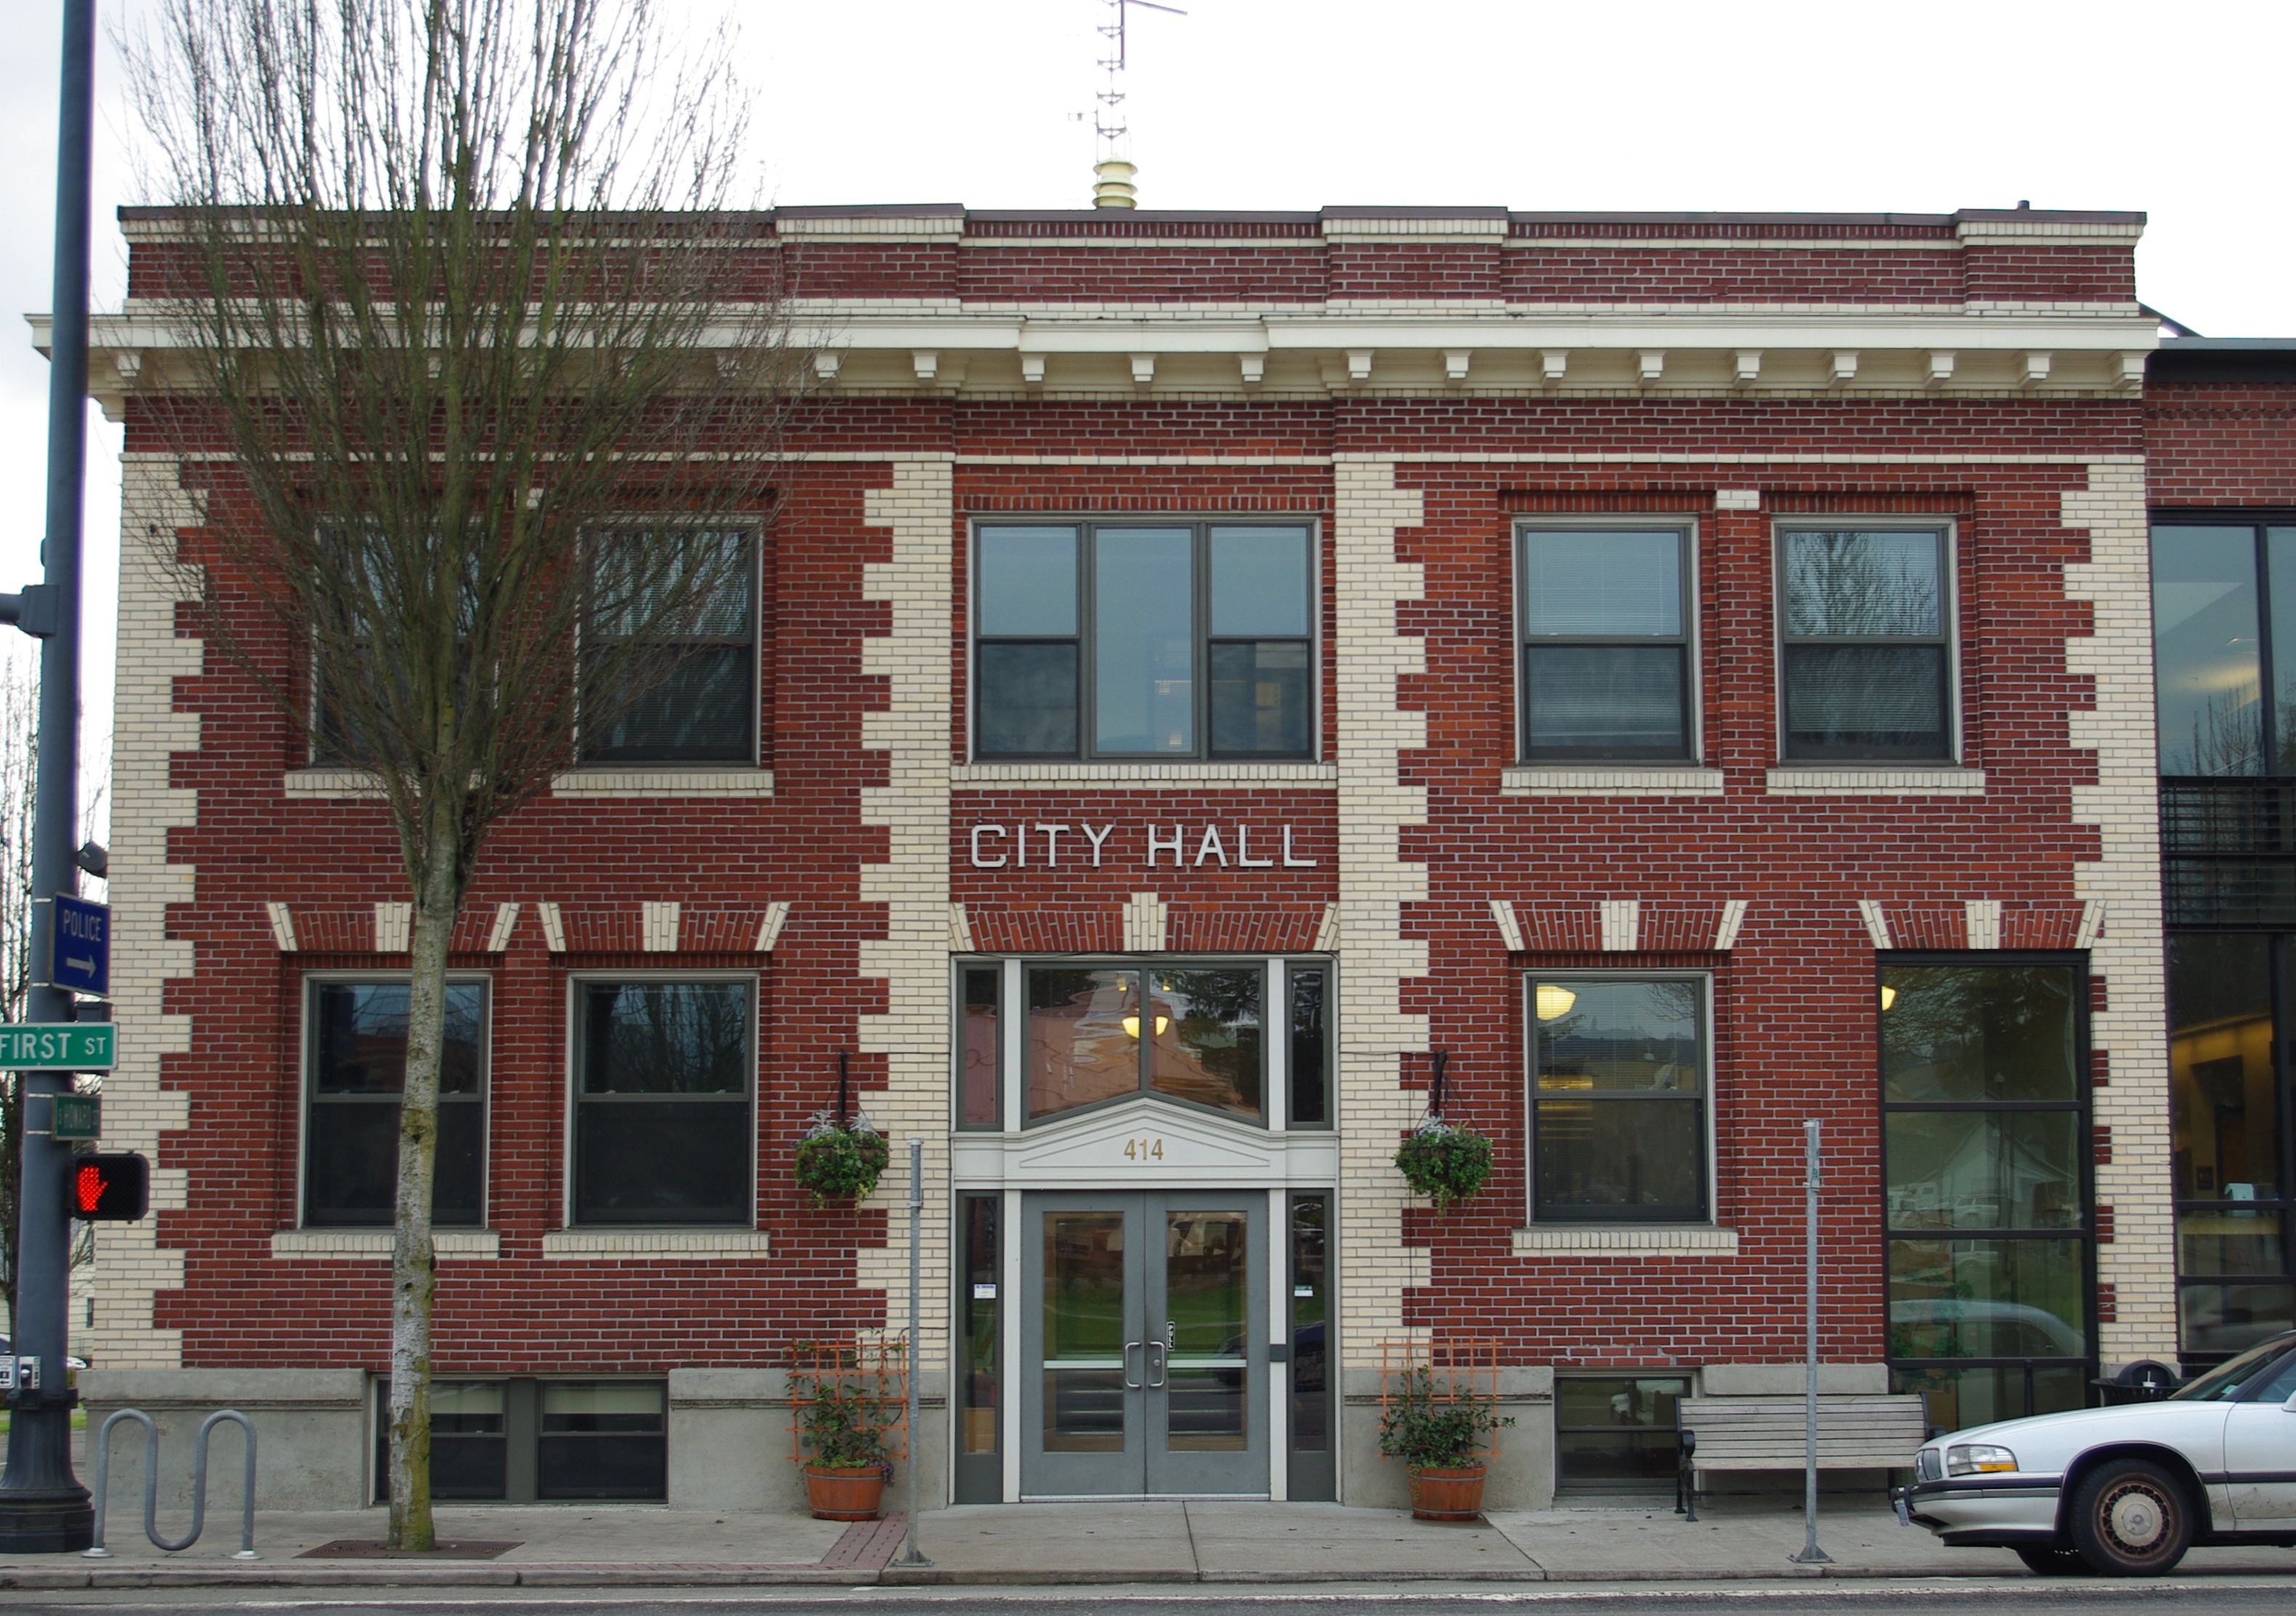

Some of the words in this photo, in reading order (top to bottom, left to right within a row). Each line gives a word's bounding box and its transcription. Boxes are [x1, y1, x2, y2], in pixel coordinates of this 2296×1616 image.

[970, 823, 1115, 868] CITY
[1147, 823, 1318, 868] HALL
[63, 908, 102, 942] POLICE
[0, 1033, 71, 1059] FIRST
[85, 1037, 106, 1055] ST
[1124, 1139, 1164, 1160] 414
